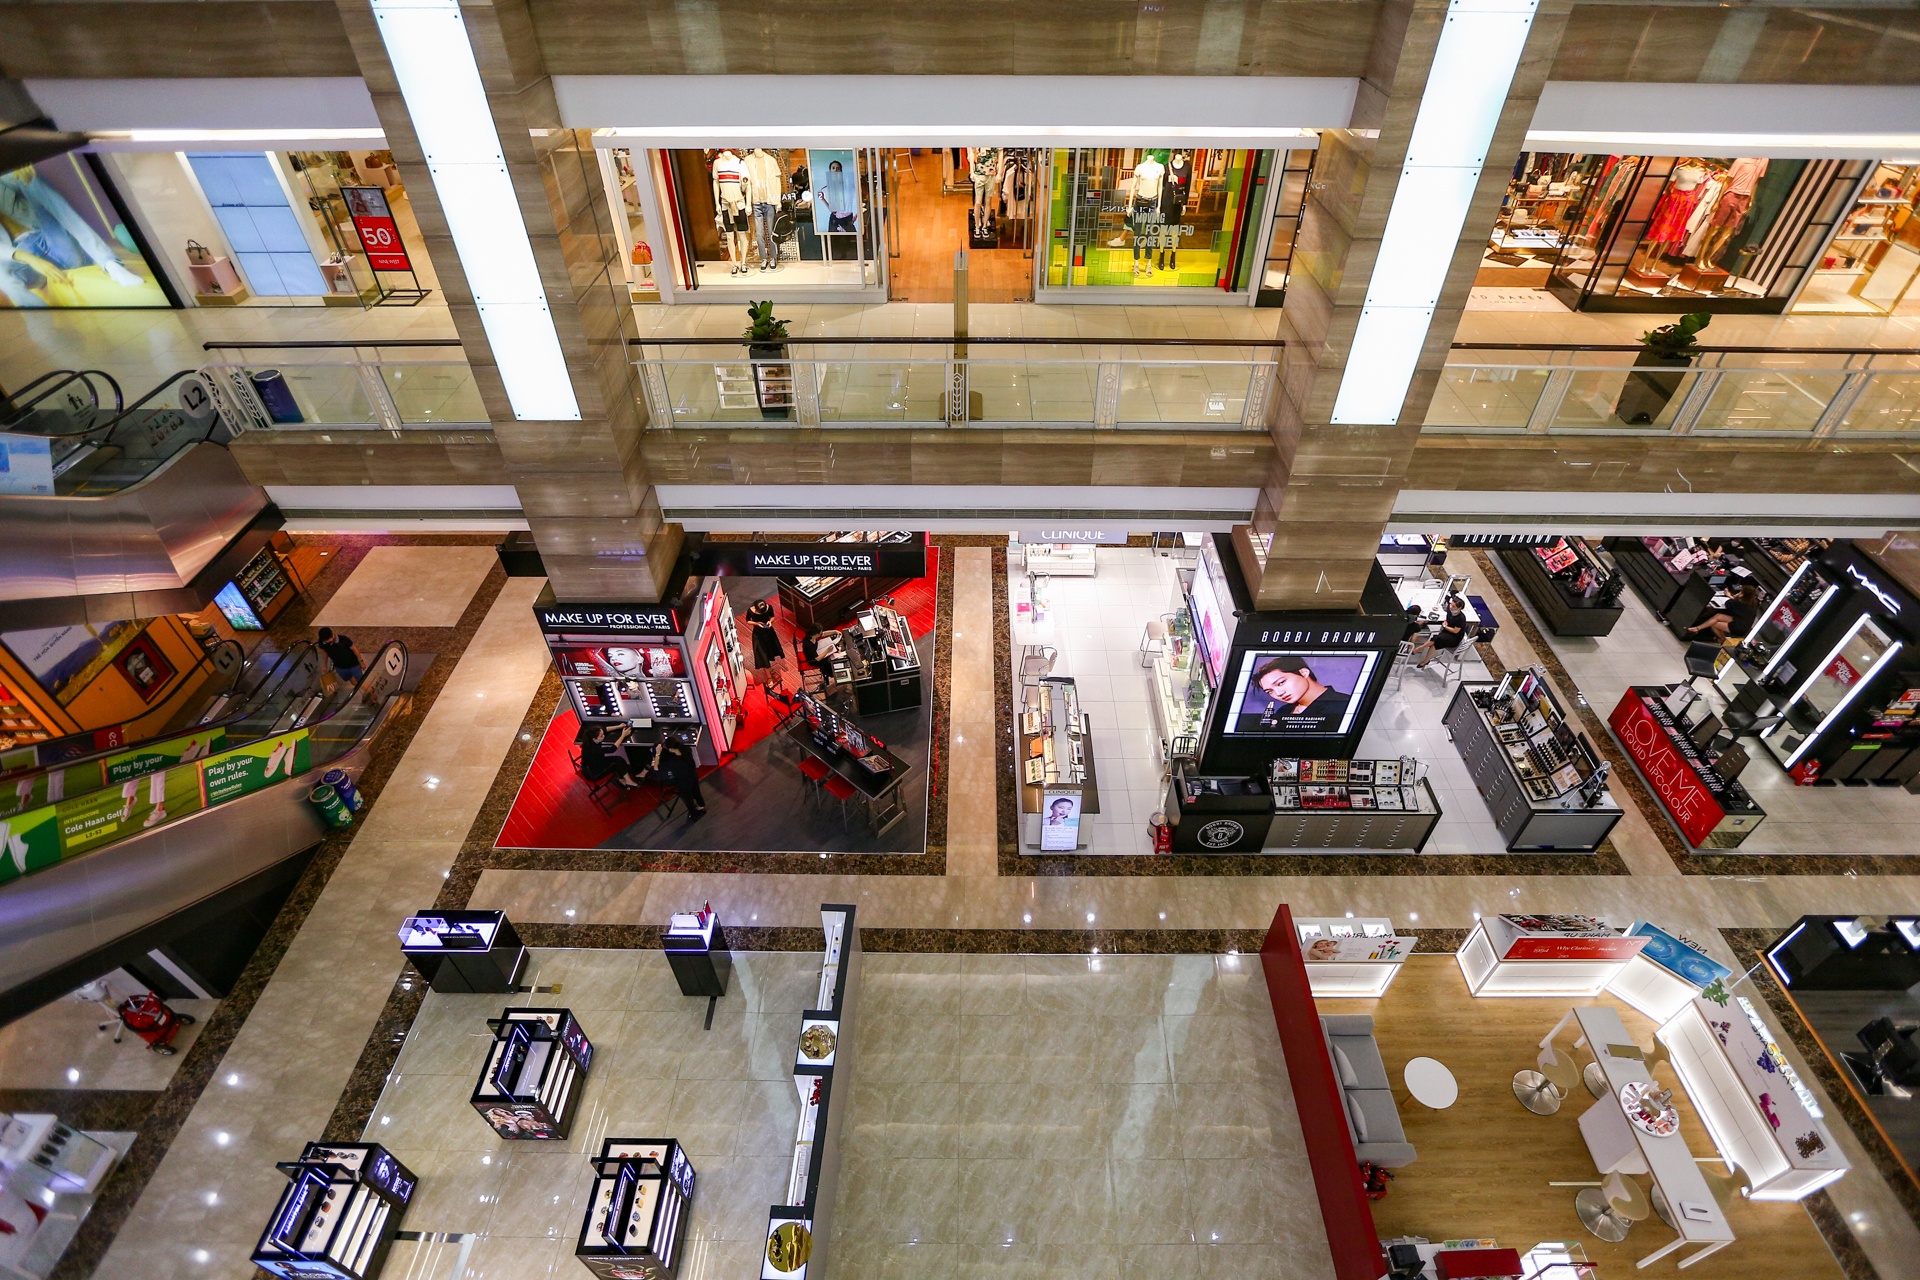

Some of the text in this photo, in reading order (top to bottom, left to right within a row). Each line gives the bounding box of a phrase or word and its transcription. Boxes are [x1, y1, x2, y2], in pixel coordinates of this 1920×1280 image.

[1135, 213, 1165, 223] MOVING
[362, 228, 391, 246] 50
[183, 386, 207, 411] L2
[754, 555, 872, 566] MAKE UP FOR EVER
[545, 613, 669, 625] MAKE UP FOR EVER
[1261, 631, 1376, 643] BOBBI BROWN
[218, 651, 234, 670] L1
[388, 652, 400, 671] L1
[113, 763, 131, 775] Play
[133, 761, 143, 769] by
[145, 756, 163, 768] your
[208, 765, 225, 776] Play
[226, 762, 236, 771] by
[237, 757, 253, 769] your
[1625, 707, 1706, 817] LOVE ME
[210, 770, 249, 787] own rules.
[1620, 724, 1691, 824] LIQUID LIPCOLOUR
[63, 810, 99, 825] INTRODUCING
[65, 809, 123, 835] Cole Haan Golf
